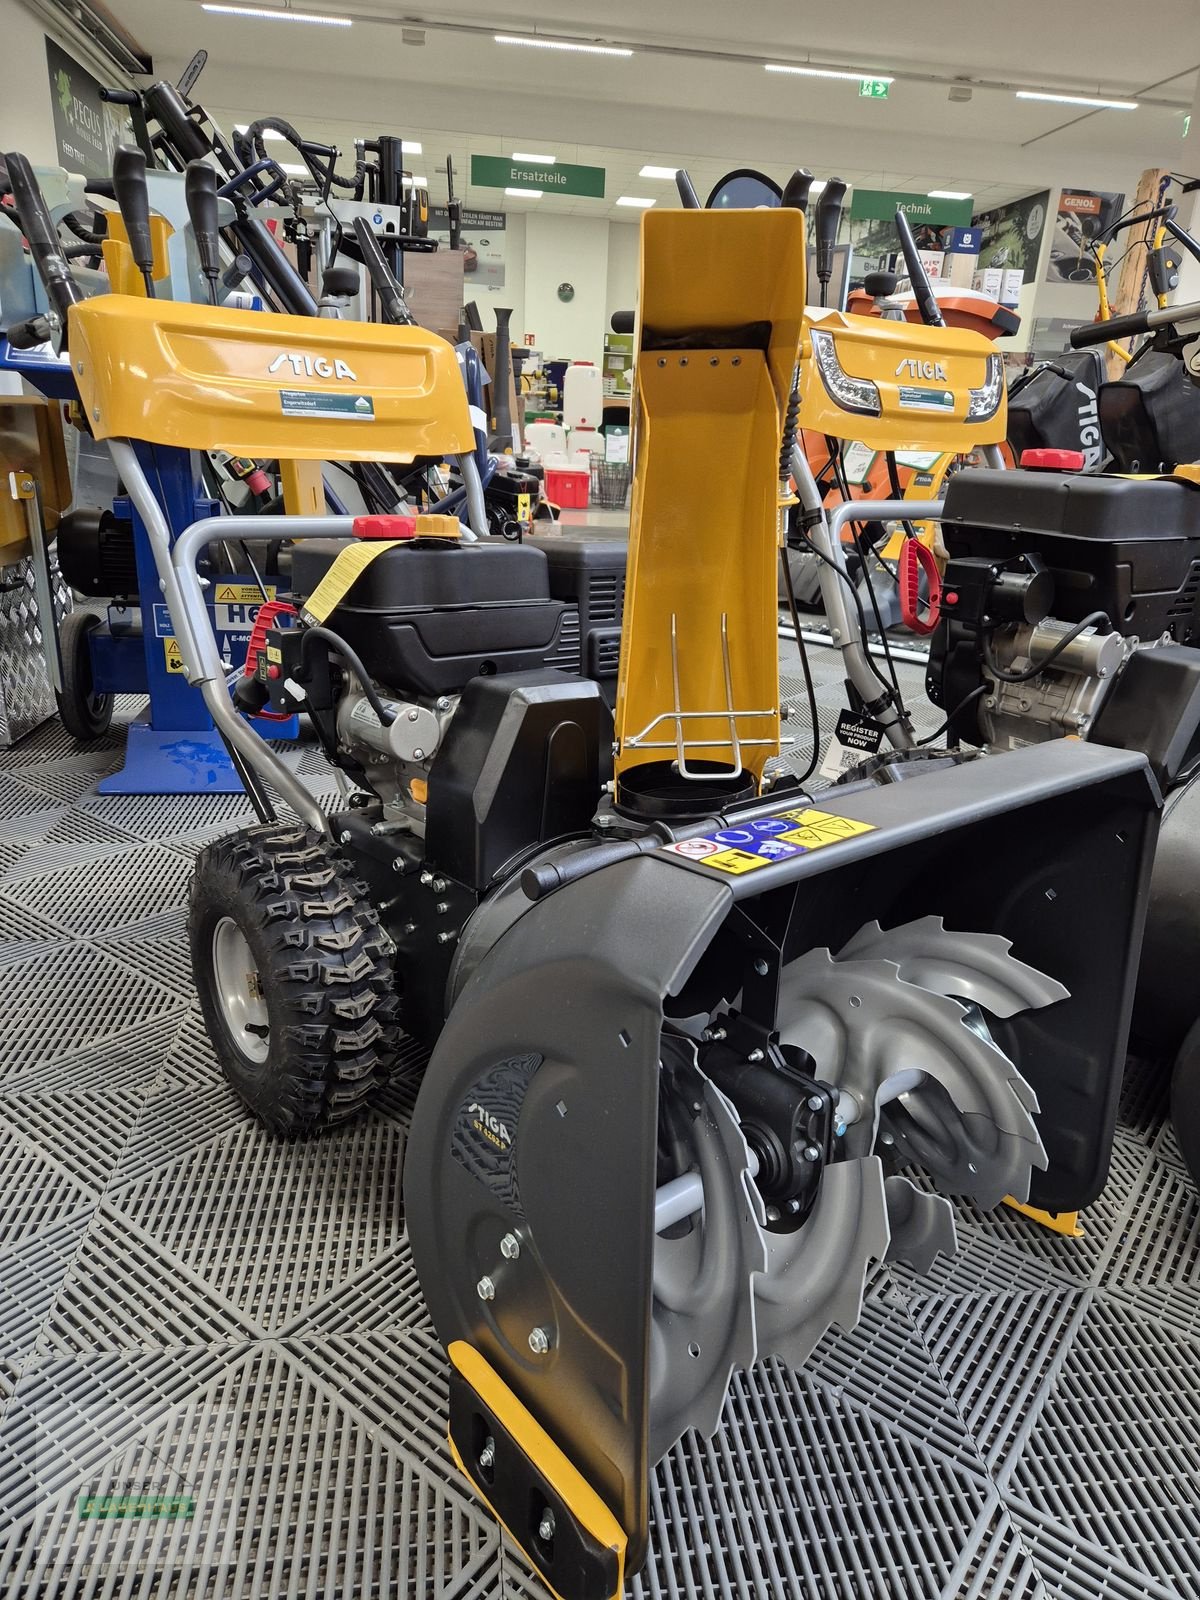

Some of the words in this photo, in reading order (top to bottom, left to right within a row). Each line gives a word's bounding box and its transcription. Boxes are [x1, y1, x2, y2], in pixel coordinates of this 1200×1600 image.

[73, 96, 101, 136] PEGUS
[510, 168, 567, 184] Ersatzteile
[896, 202, 932, 214] Technik
[1064, 198, 1096, 208] GENOL
[269, 354, 356, 381] STIGA
[895, 358, 947, 382] STIGA
[1076, 382, 1100, 473] STIGA
[841, 723, 878, 737] REGISTER
[853, 732, 878, 743] PRODUCT
[847, 737, 868, 747] NOW
[469, 1103, 511, 1144] STIGA
